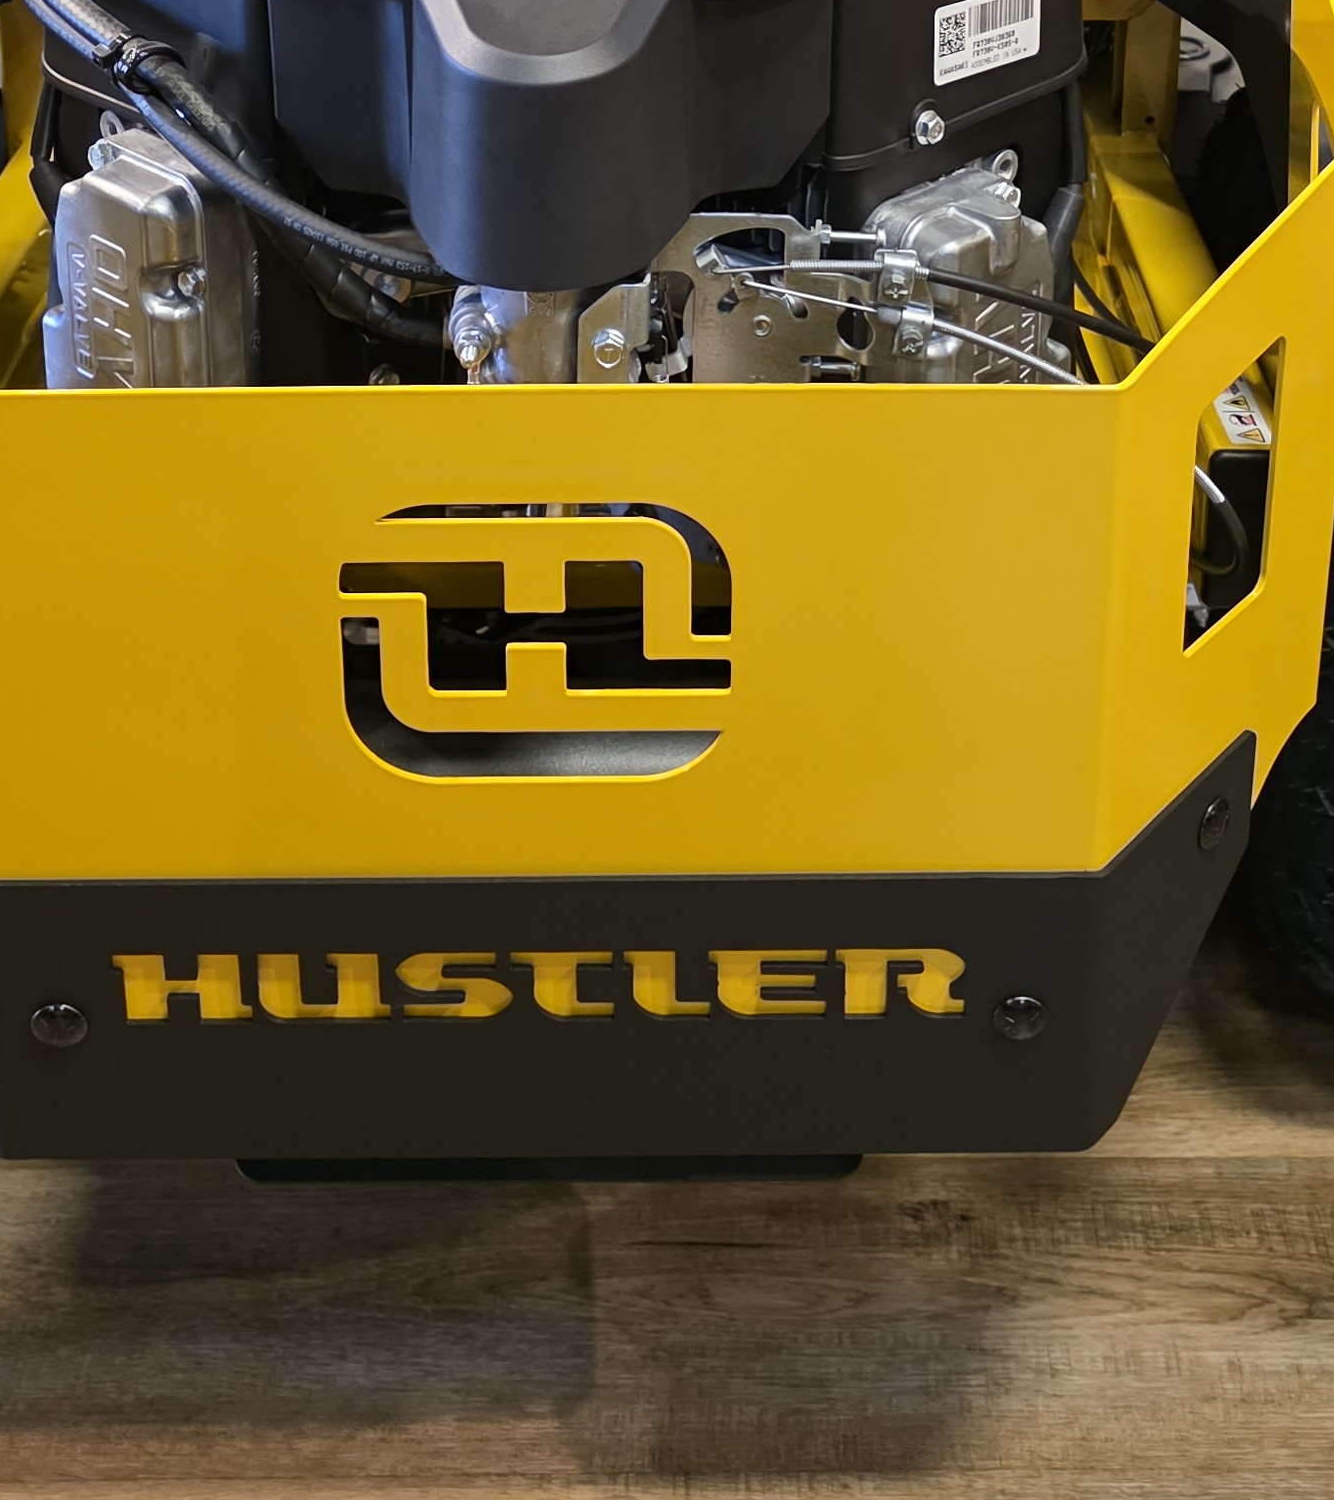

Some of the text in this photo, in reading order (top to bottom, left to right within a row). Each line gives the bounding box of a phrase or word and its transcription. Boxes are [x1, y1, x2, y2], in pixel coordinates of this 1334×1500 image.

[939, 47, 1021, 77] KAWASAKI ASSEMBLED IN USA
[111, 948, 967, 1024] HUSTLER
